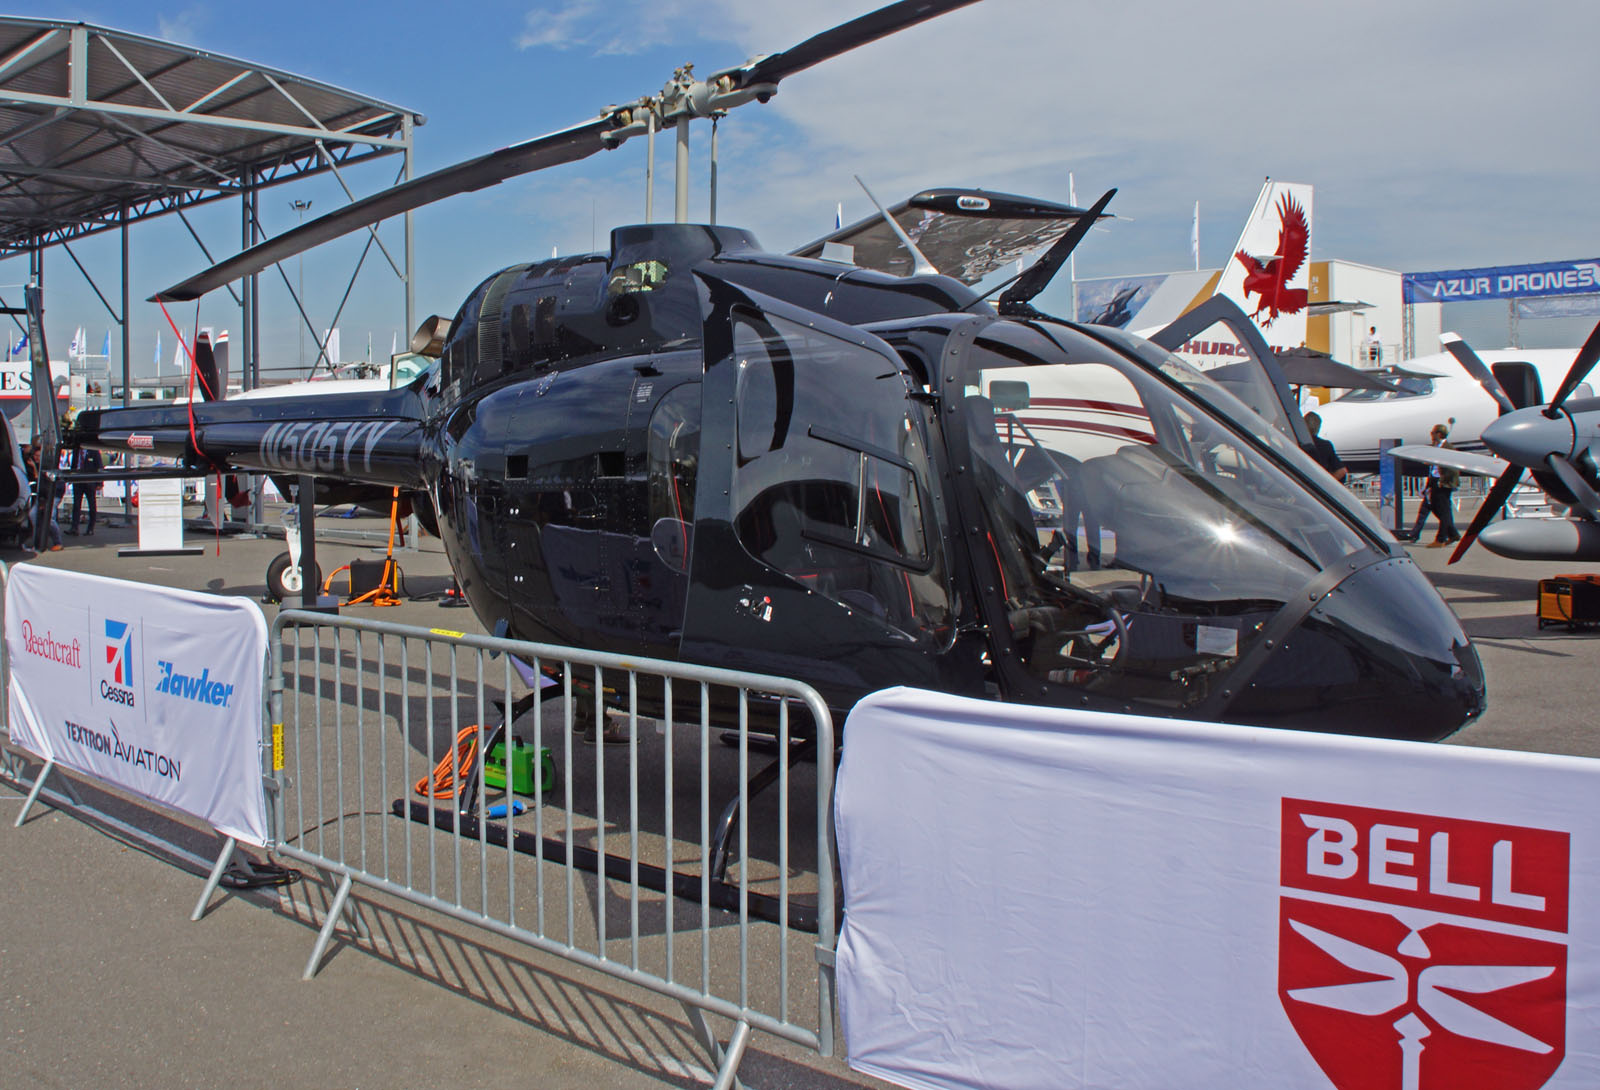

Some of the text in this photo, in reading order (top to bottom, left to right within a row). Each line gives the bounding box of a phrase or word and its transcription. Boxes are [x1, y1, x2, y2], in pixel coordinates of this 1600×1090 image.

[1432, 269, 1594, 297] AZUR DRONES
[260, 421, 400, 473] N505YY
[22, 619, 81, 669] Beechcraft
[100, 679, 135, 707] Cessna
[155, 660, 234, 708] Hawker
[65, 718, 181, 782] TEXTRON AVIATION
[1299, 813, 1546, 912] BELL
